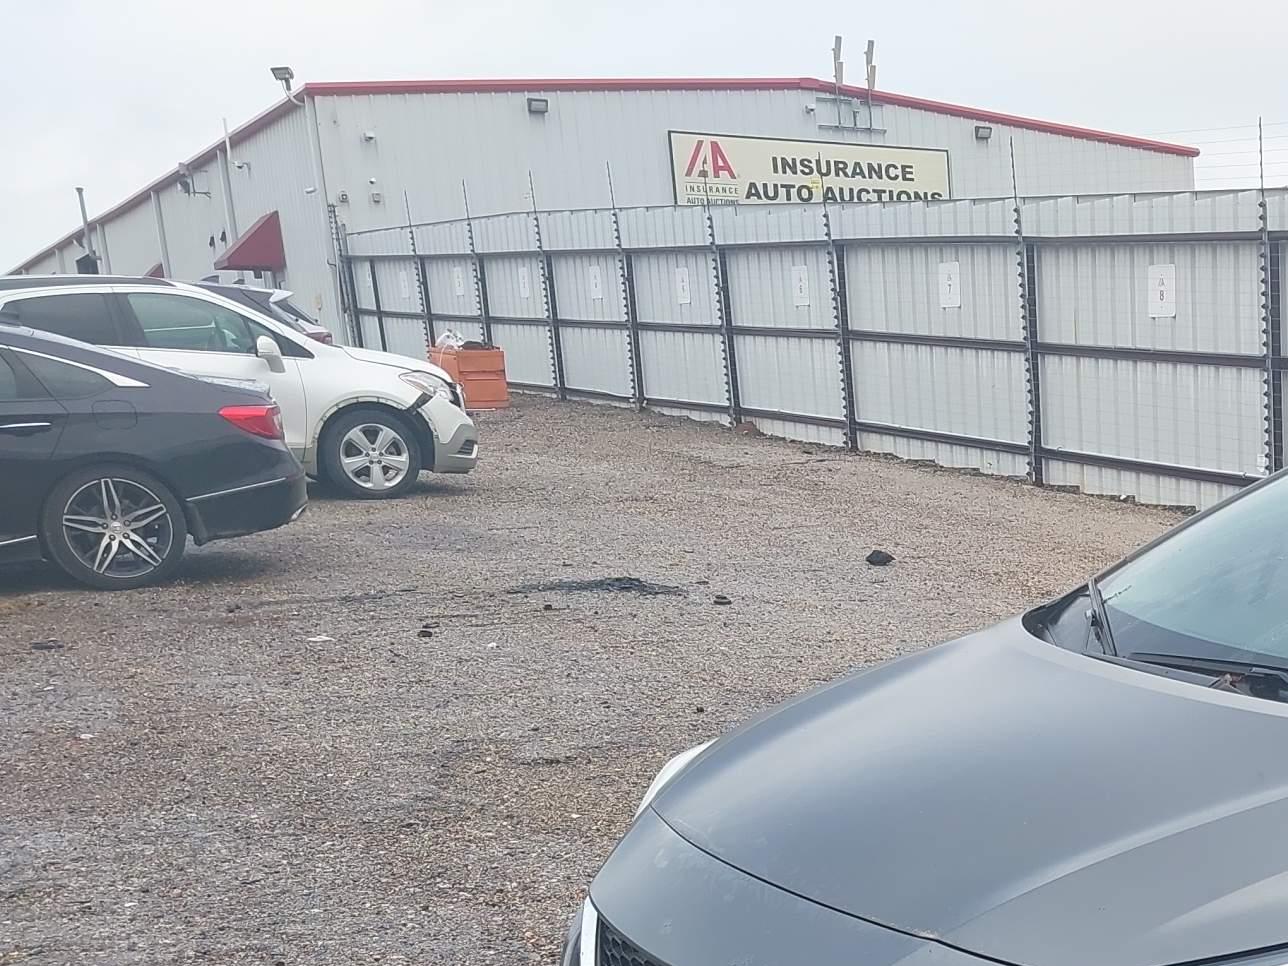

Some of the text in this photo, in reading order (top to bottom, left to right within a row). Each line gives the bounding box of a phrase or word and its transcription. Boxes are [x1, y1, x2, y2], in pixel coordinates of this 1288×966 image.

[772, 155, 915, 182] INSURANCE
[685, 184, 739, 195] INSURANCE
[745, 182, 814, 203] AUTO
[686, 197, 705, 205] AUTO
